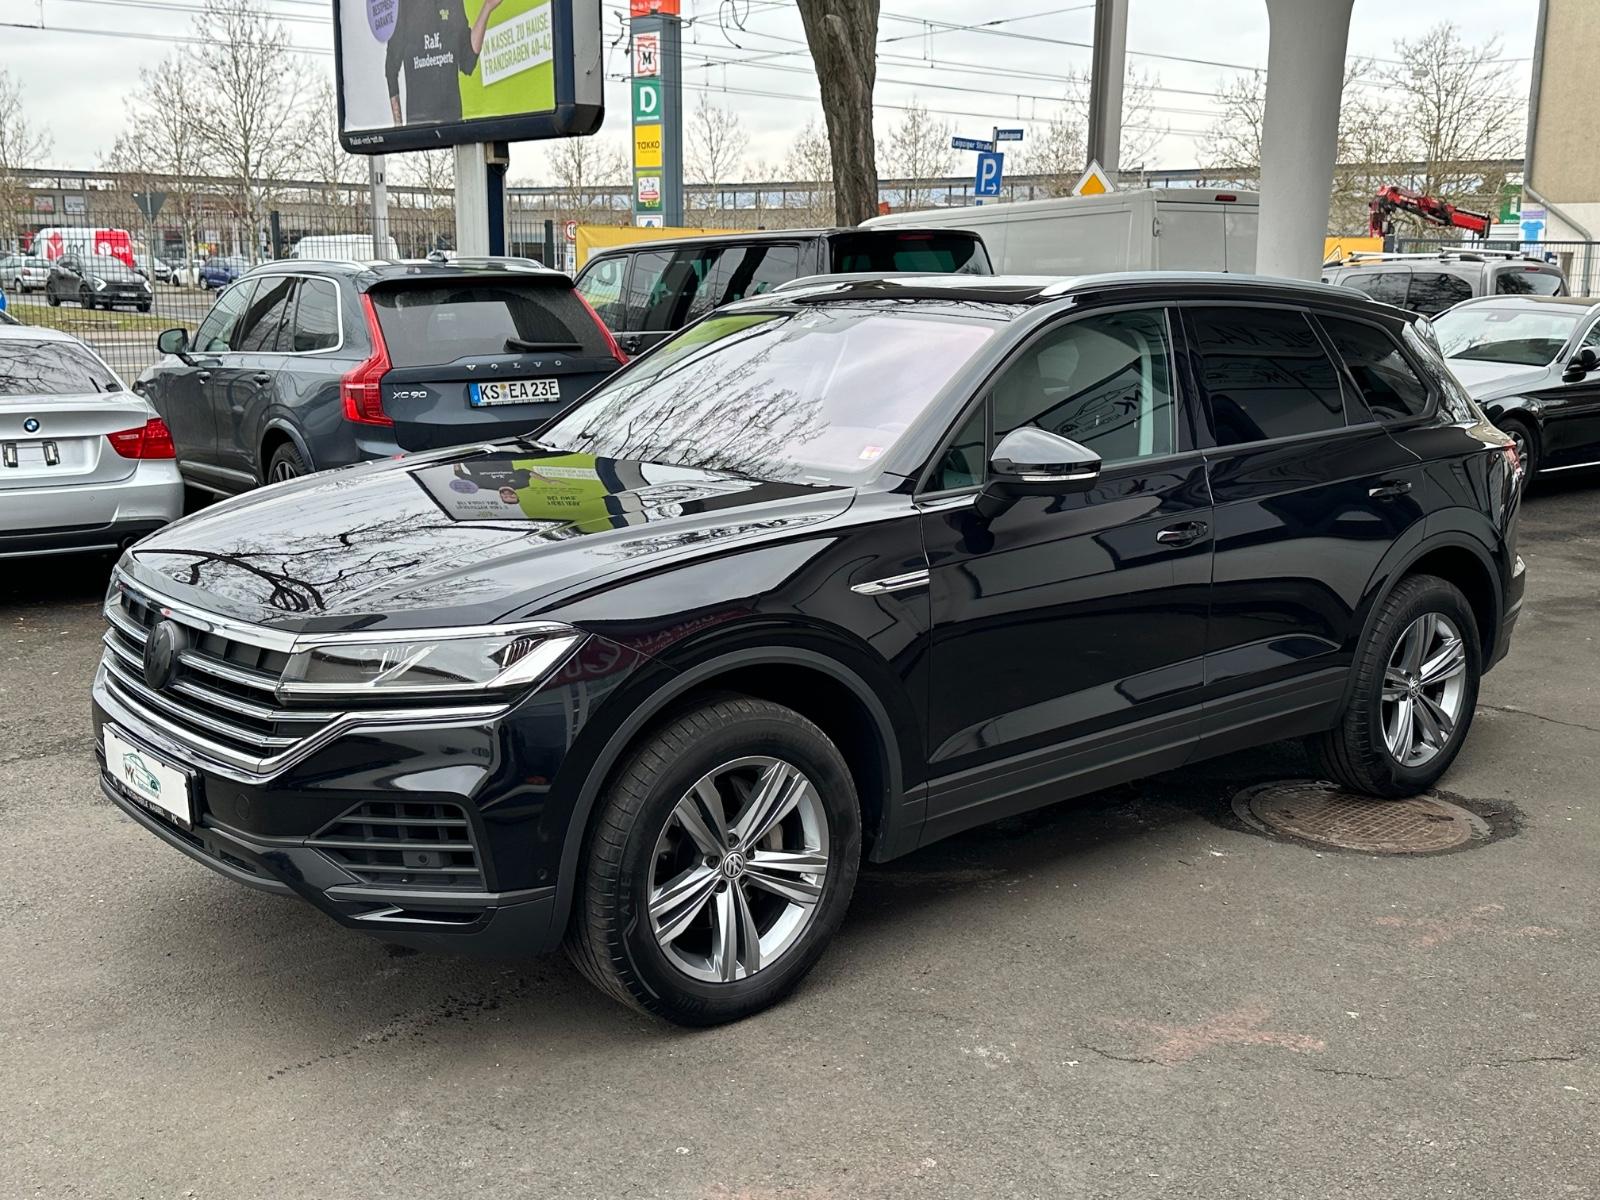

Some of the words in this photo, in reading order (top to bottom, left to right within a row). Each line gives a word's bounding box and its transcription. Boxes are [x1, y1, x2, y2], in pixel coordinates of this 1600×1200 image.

[424, 32, 442, 50] Ralf,
[491, 28, 515, 52] KASSEL
[516, 22, 525, 42] ZU
[526, 12, 548, 37] HAUSE
[413, 51, 454, 70] Hundeexperte
[485, 42, 530, 76] FRANZGRABEN
[531, 33, 551, 57] 40-42
[642, 52, 652, 65] M
[640, 86, 657, 113] D
[637, 140, 660, 150] TOKKO
[981, 159, 997, 192] P
[466, 360, 562, 371] VOLVO
[480, 384, 500, 400] KS
[509, 382, 529, 399] EA
[530, 380, 559, 397] 23E
